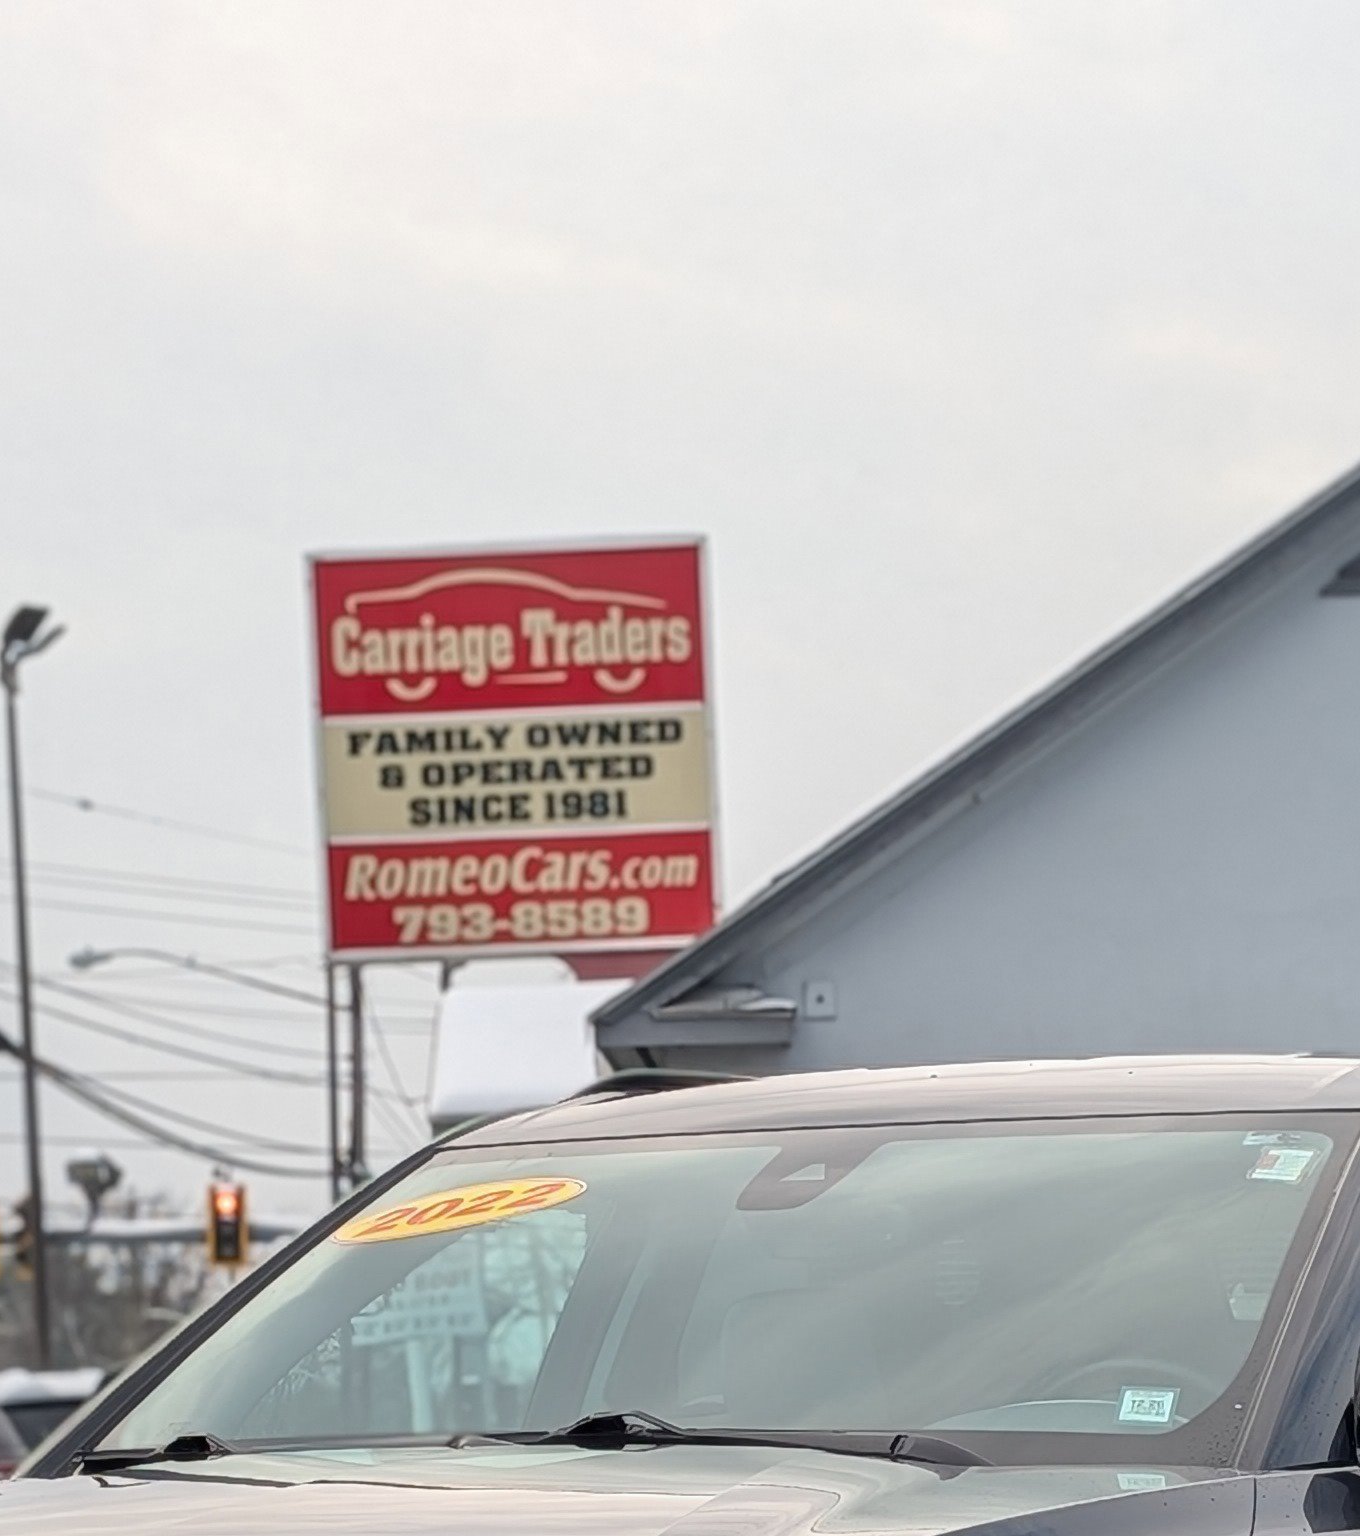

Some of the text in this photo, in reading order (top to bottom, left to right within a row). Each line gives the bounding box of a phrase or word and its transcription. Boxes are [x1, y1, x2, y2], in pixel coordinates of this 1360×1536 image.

[331, 605, 692, 687] Carriage Traders
[348, 718, 684, 756] FAMILY OWNED
[379, 755, 655, 789] & OPERATED
[409, 790, 627, 827] SINCE 1981
[345, 846, 699, 901] RomeoCars.com
[392, 896, 649, 944] 793-8589
[351, 1182, 566, 1238] 2022
